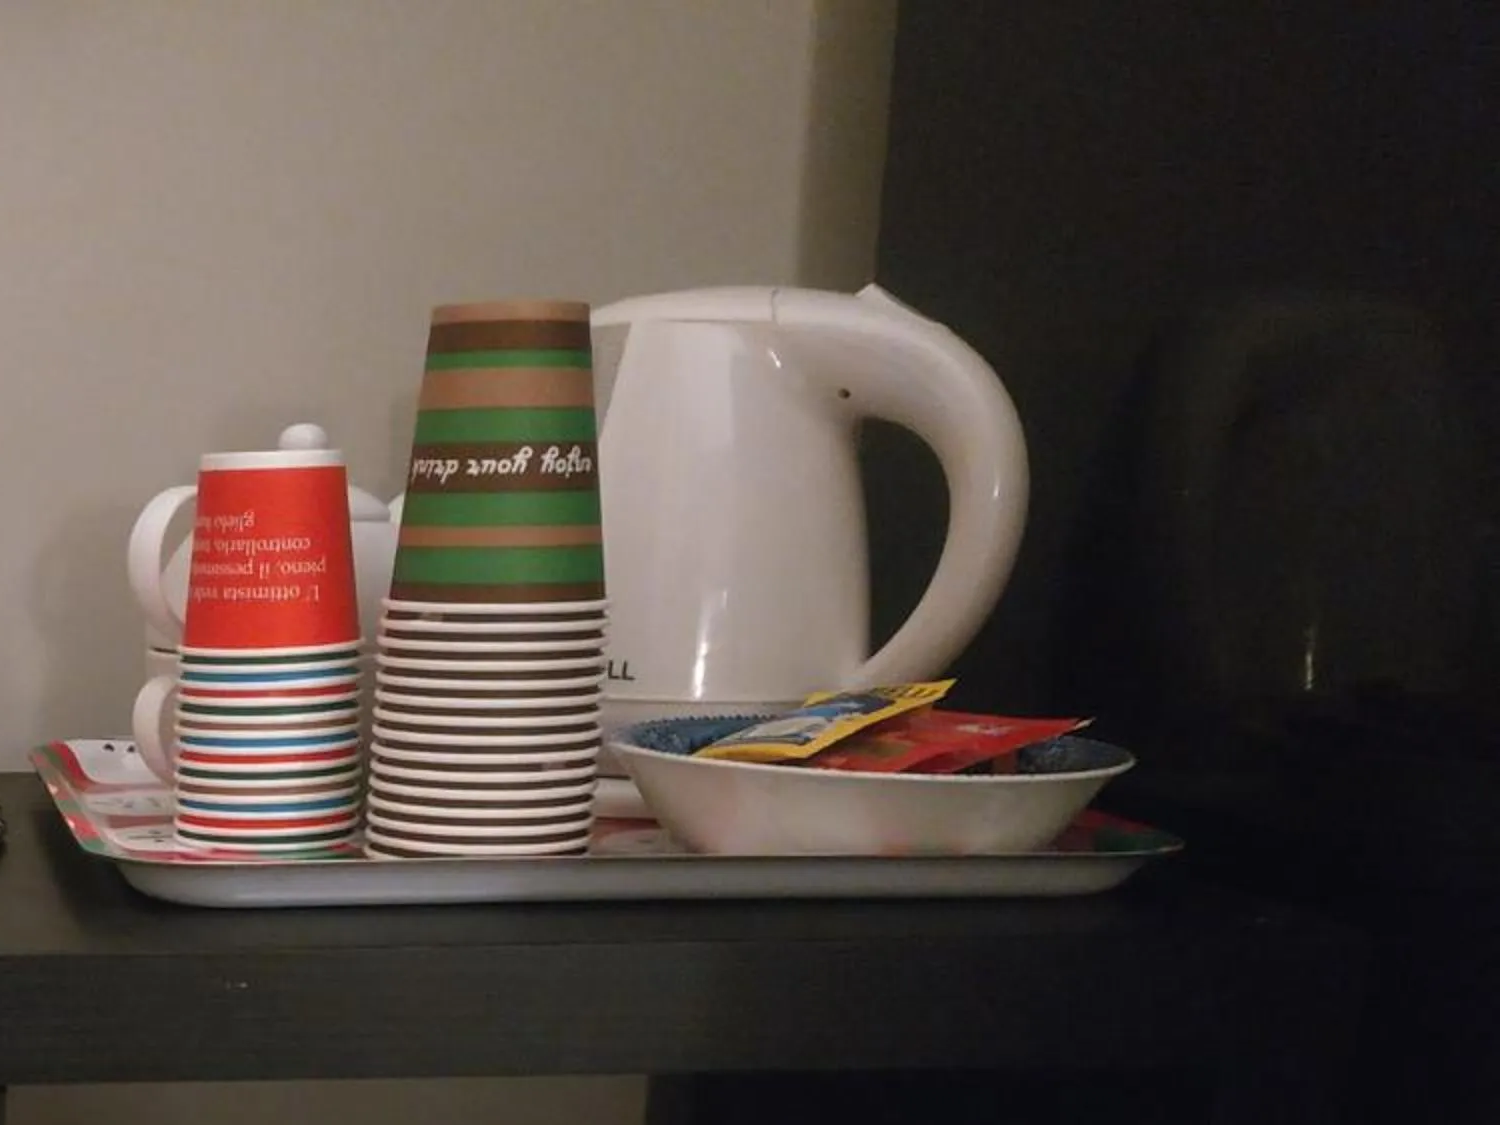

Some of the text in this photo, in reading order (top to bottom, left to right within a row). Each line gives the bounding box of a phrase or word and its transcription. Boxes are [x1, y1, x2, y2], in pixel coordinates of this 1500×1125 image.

[466, 445, 534, 477] your
[222, 584, 301, 602] ottimista
[605, 659, 636, 681] LL
